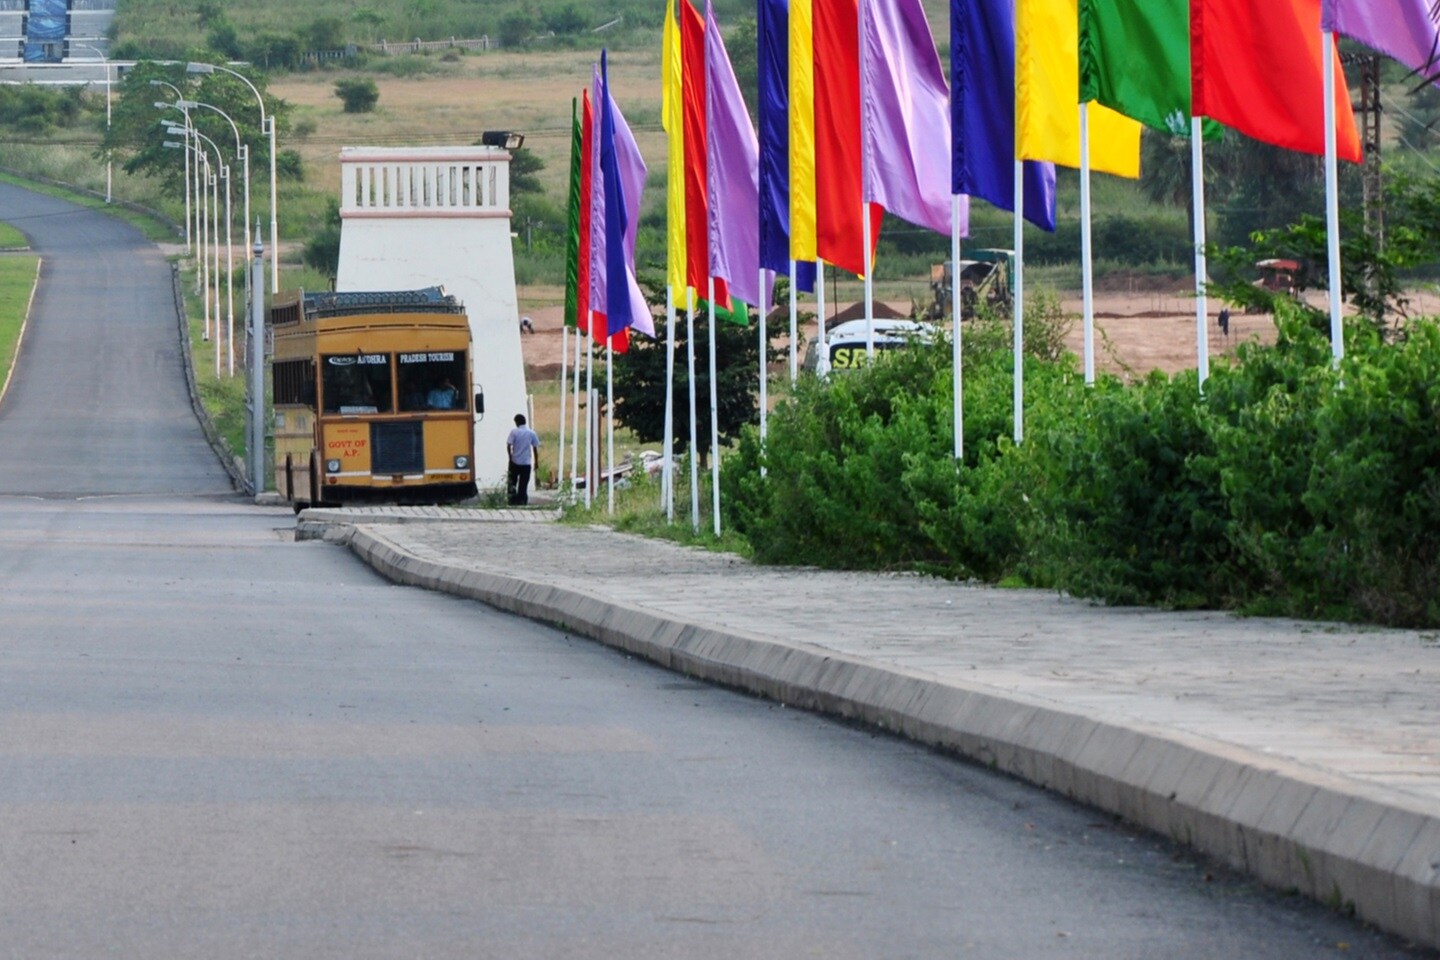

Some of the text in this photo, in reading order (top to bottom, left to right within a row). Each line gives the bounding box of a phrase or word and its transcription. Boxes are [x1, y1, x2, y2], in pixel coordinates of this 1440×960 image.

[328, 439, 367, 448] GOVT OF
[343, 449, 360, 457] A.P.
